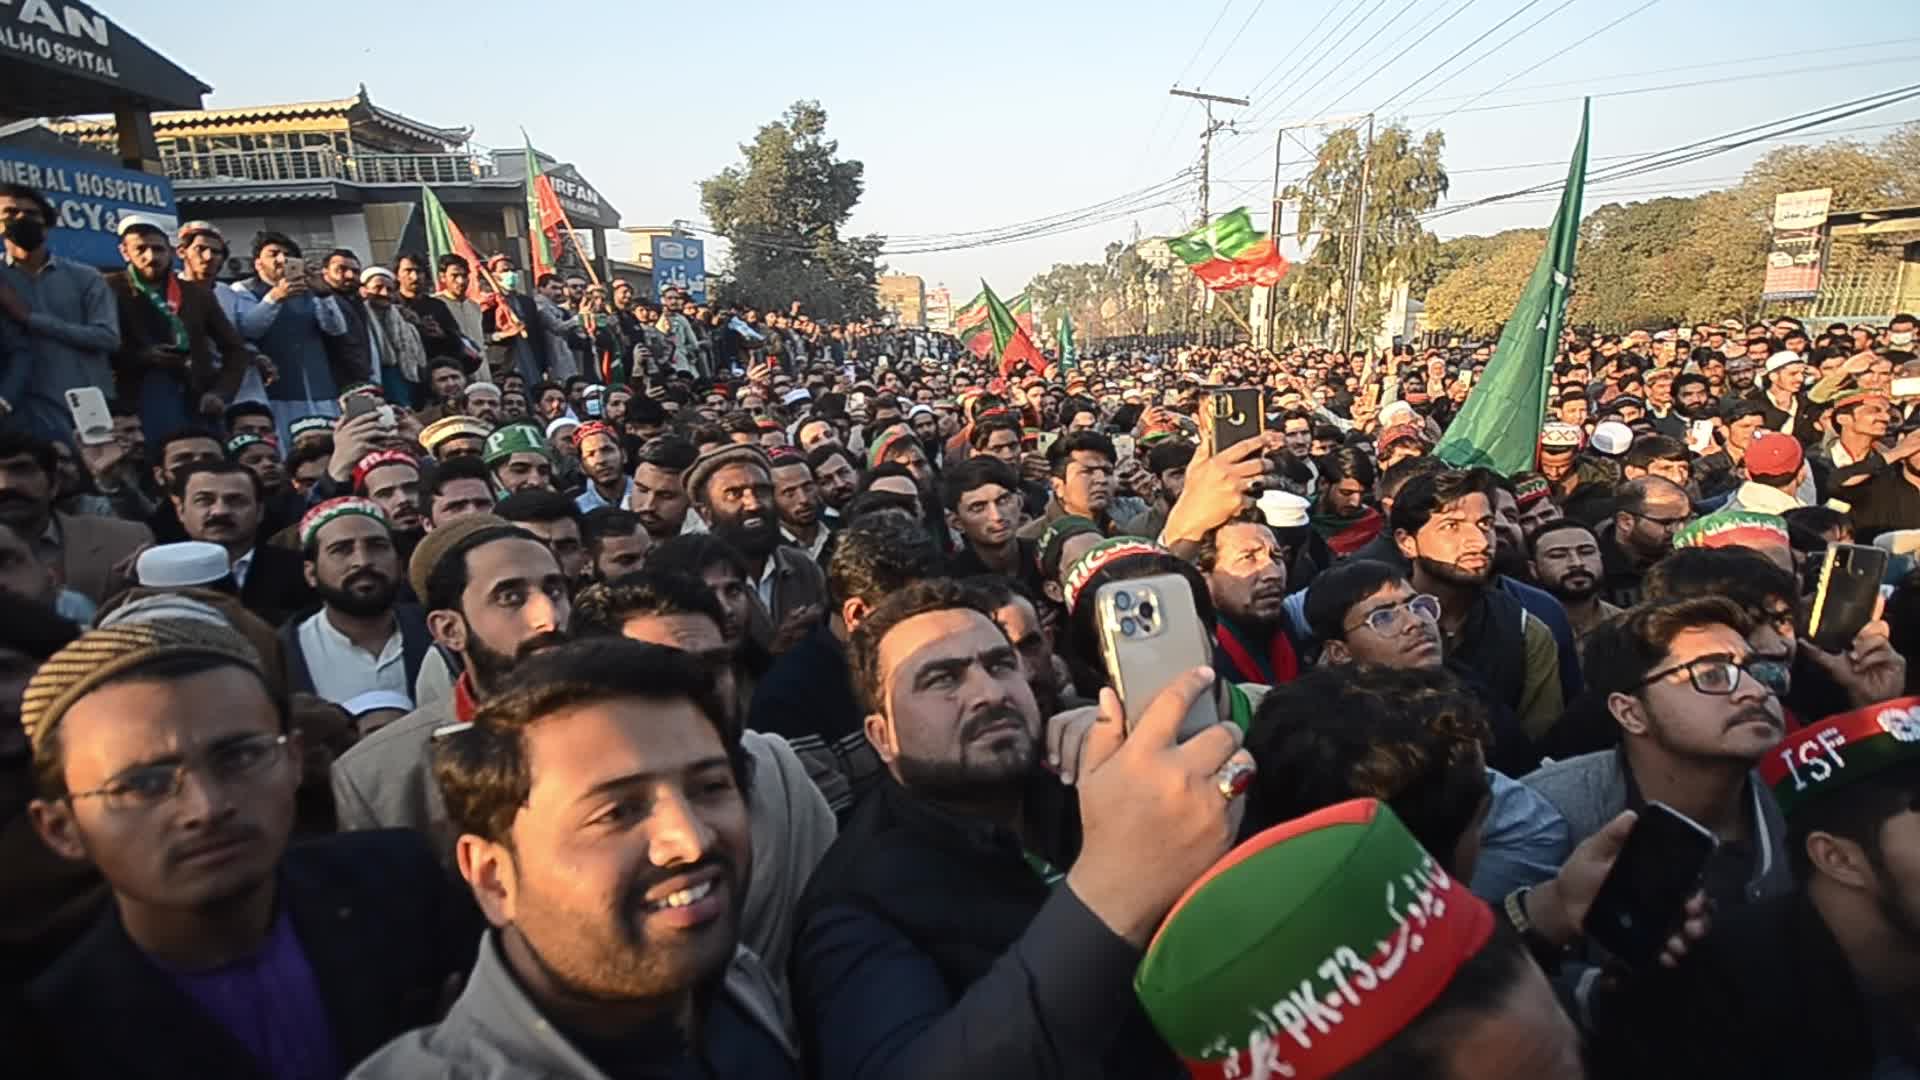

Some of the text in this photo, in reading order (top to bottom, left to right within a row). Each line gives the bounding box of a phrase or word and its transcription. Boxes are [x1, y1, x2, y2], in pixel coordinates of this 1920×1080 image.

[0, 0, 109, 47] AN
[75, 171, 167, 207] HOSPITAL
[1780, 727, 1846, 792] ISF
